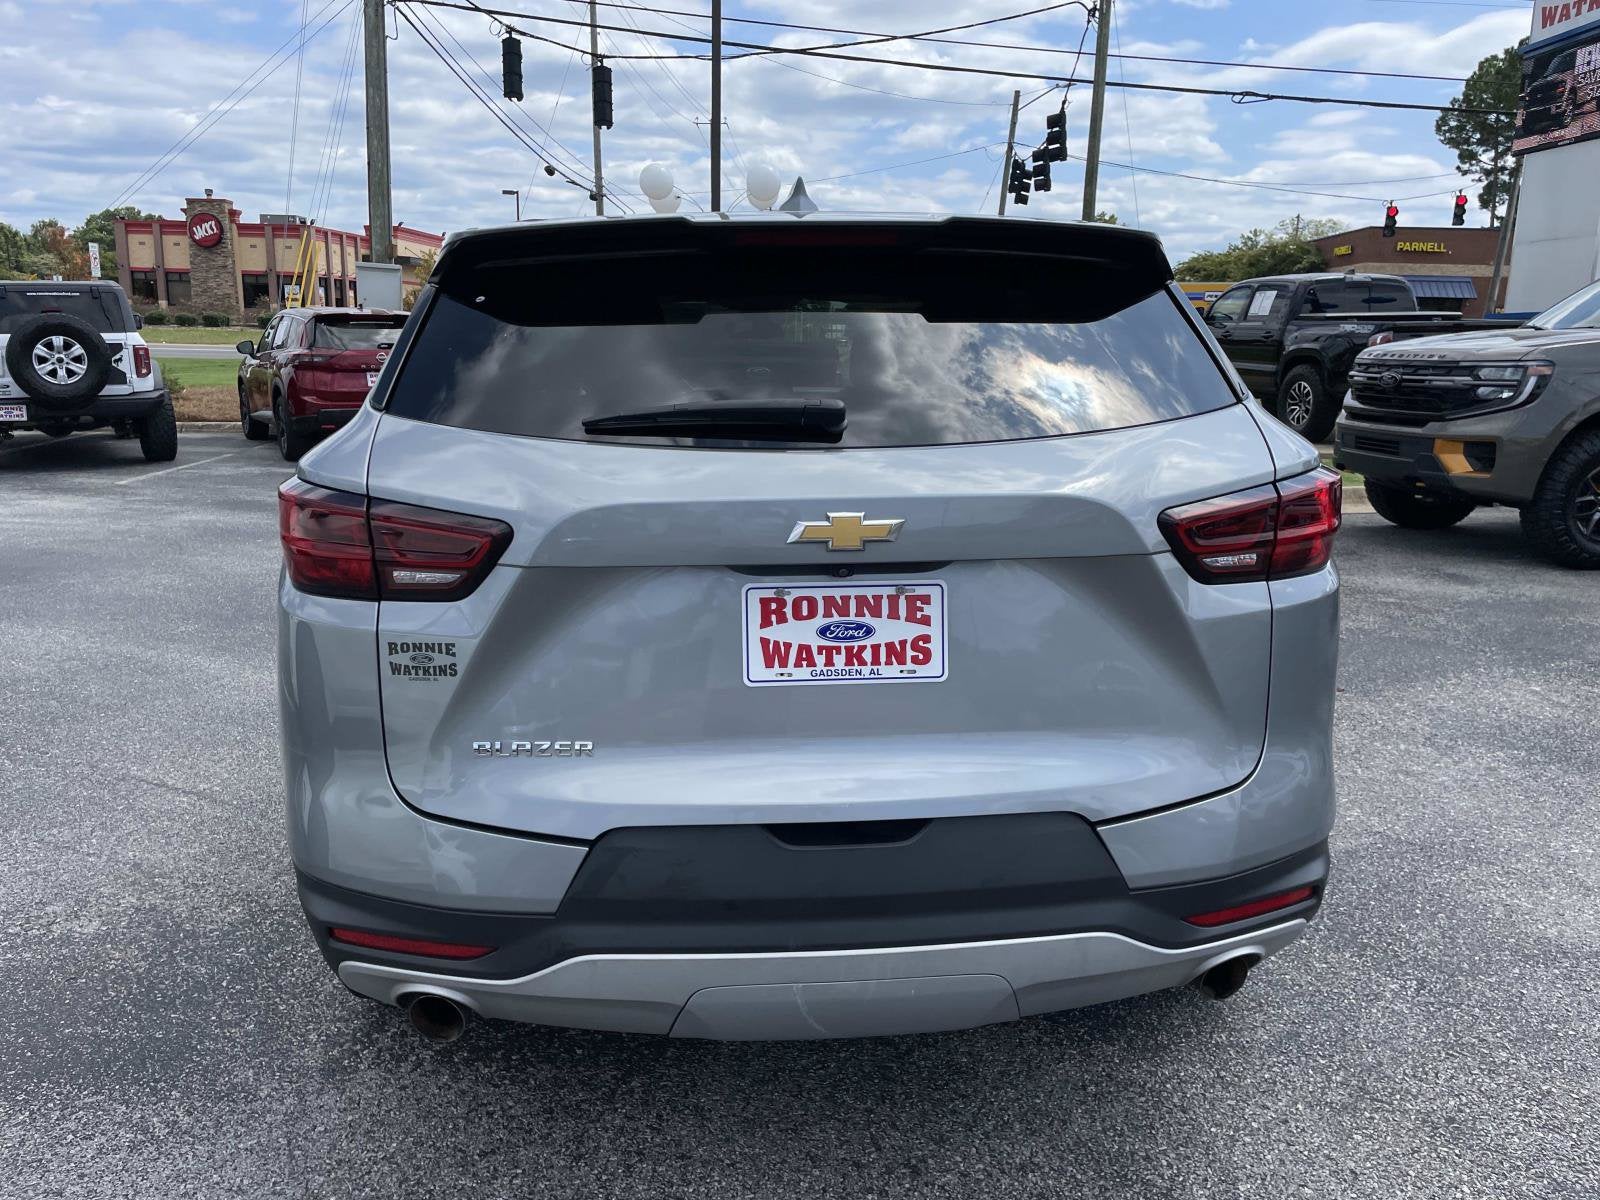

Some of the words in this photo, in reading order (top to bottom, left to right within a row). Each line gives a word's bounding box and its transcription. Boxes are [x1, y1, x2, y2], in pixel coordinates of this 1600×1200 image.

[1397, 242, 1447, 253] PARNELL
[759, 594, 932, 630] RONNIE
[826, 623, 868, 639] Ford
[387, 641, 457, 657] RONNIE
[759, 633, 933, 669] WATKINS
[389, 661, 458, 677] WATKINS
[810, 668, 866, 678] GADSDEN,
[868, 668, 883, 677] AL
[472, 741, 594, 757] BLAZER
